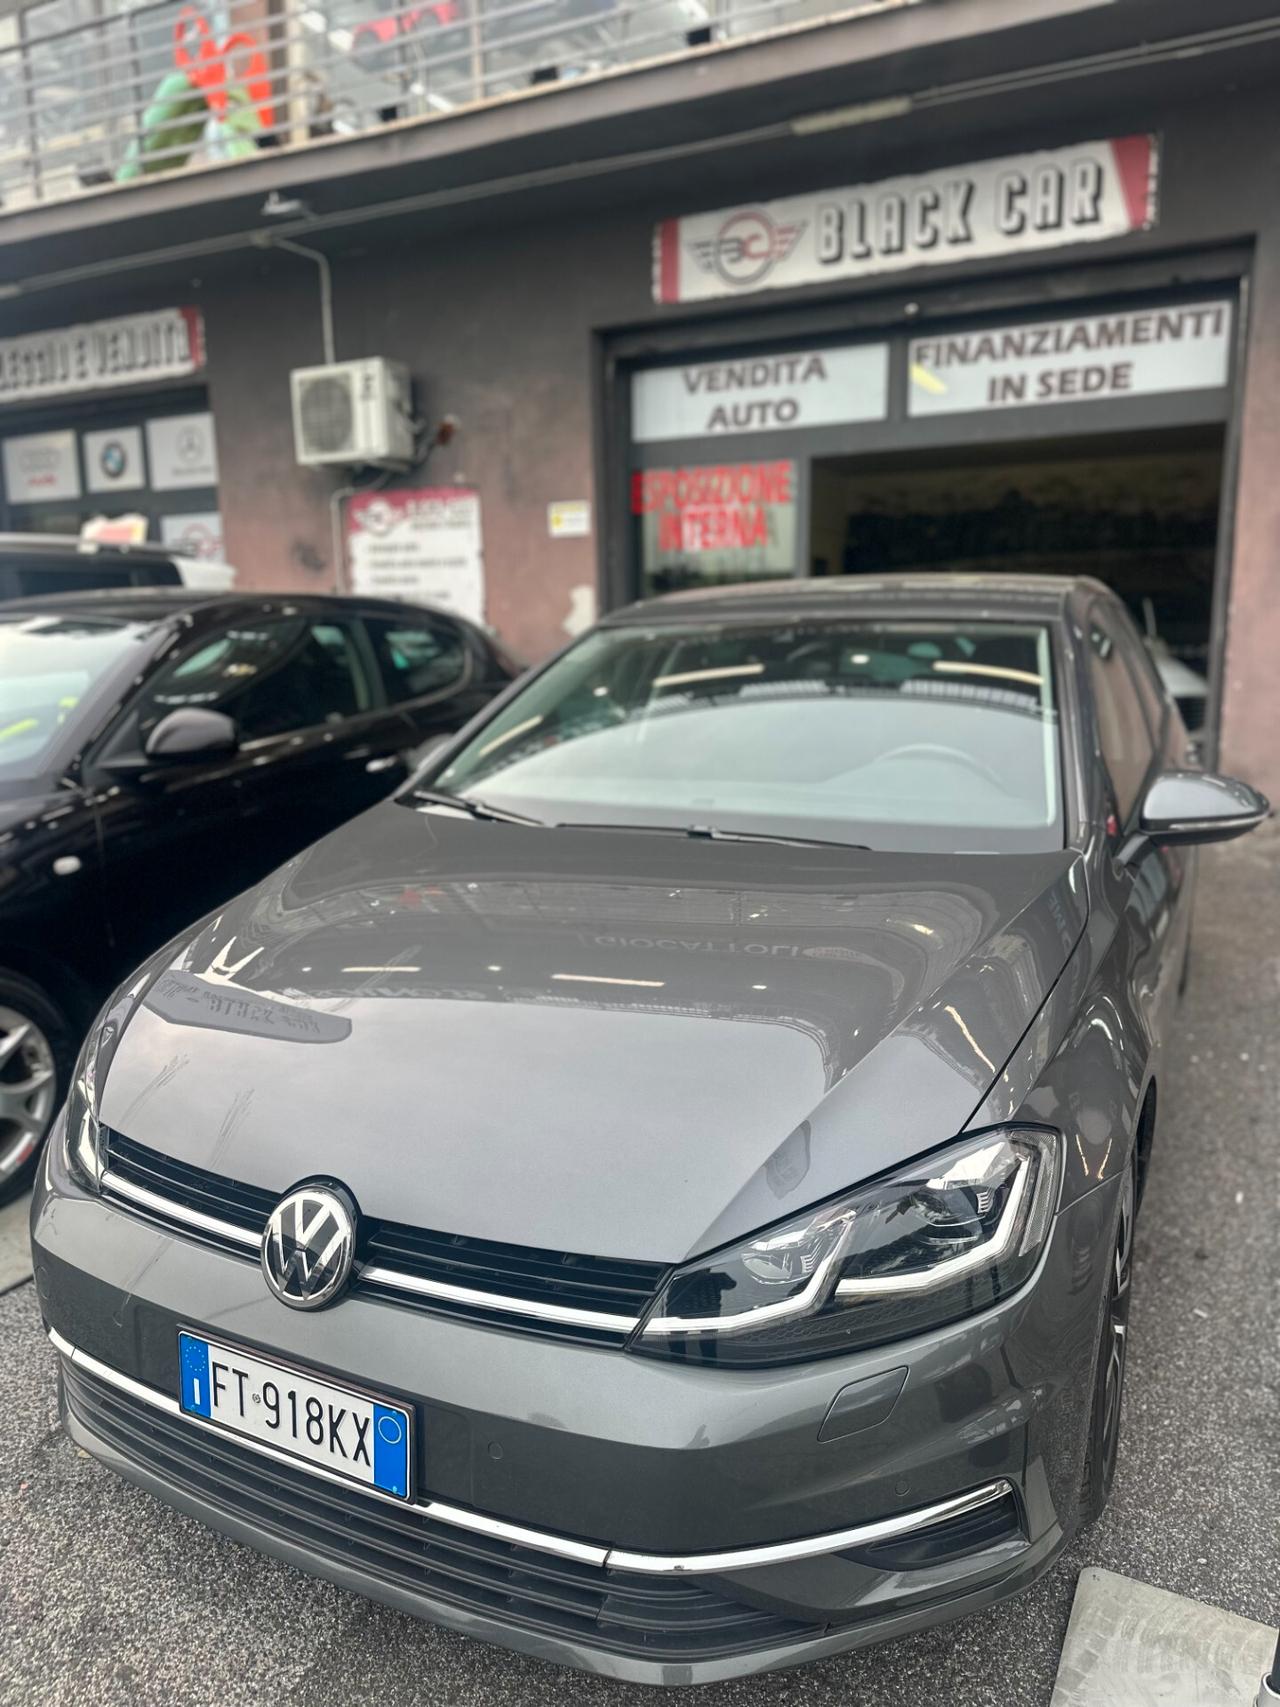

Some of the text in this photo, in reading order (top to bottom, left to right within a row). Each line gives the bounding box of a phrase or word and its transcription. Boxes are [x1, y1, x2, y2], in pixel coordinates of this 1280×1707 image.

[816, 156, 1104, 264] BLACK CAR
[914, 307, 1224, 368] FINANZIAMENTI
[682, 353, 828, 394] VENDITA
[988, 361, 1134, 403] IN SEDE
[707, 397, 800, 431] AUTO
